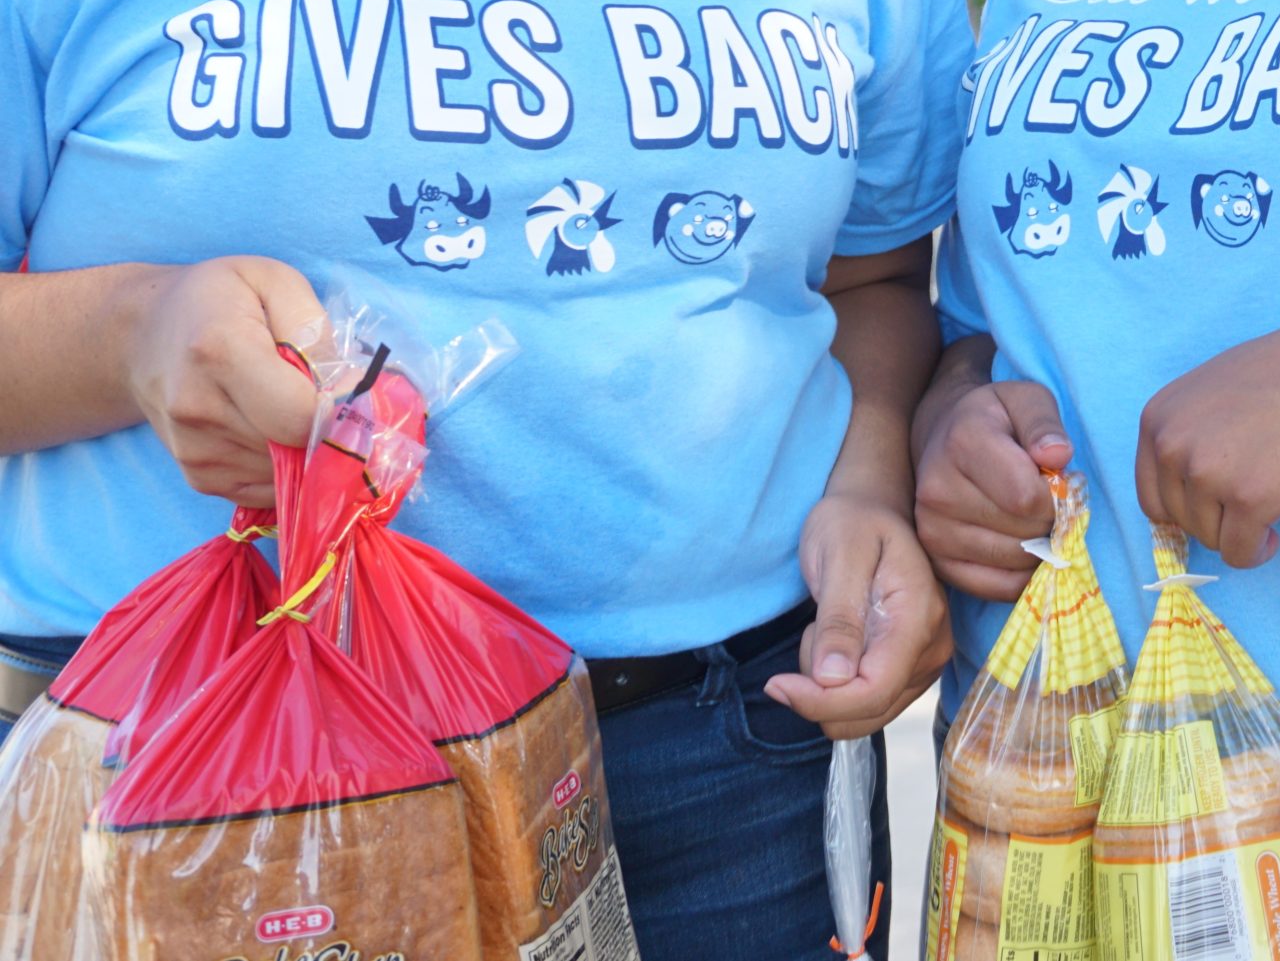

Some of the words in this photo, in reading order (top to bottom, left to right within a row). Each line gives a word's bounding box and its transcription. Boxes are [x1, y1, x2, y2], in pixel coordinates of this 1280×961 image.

[603, 3, 859, 160] BACK
[961, 12, 1184, 147] IVES
[1265, 869, 1280, 911] Wheat
